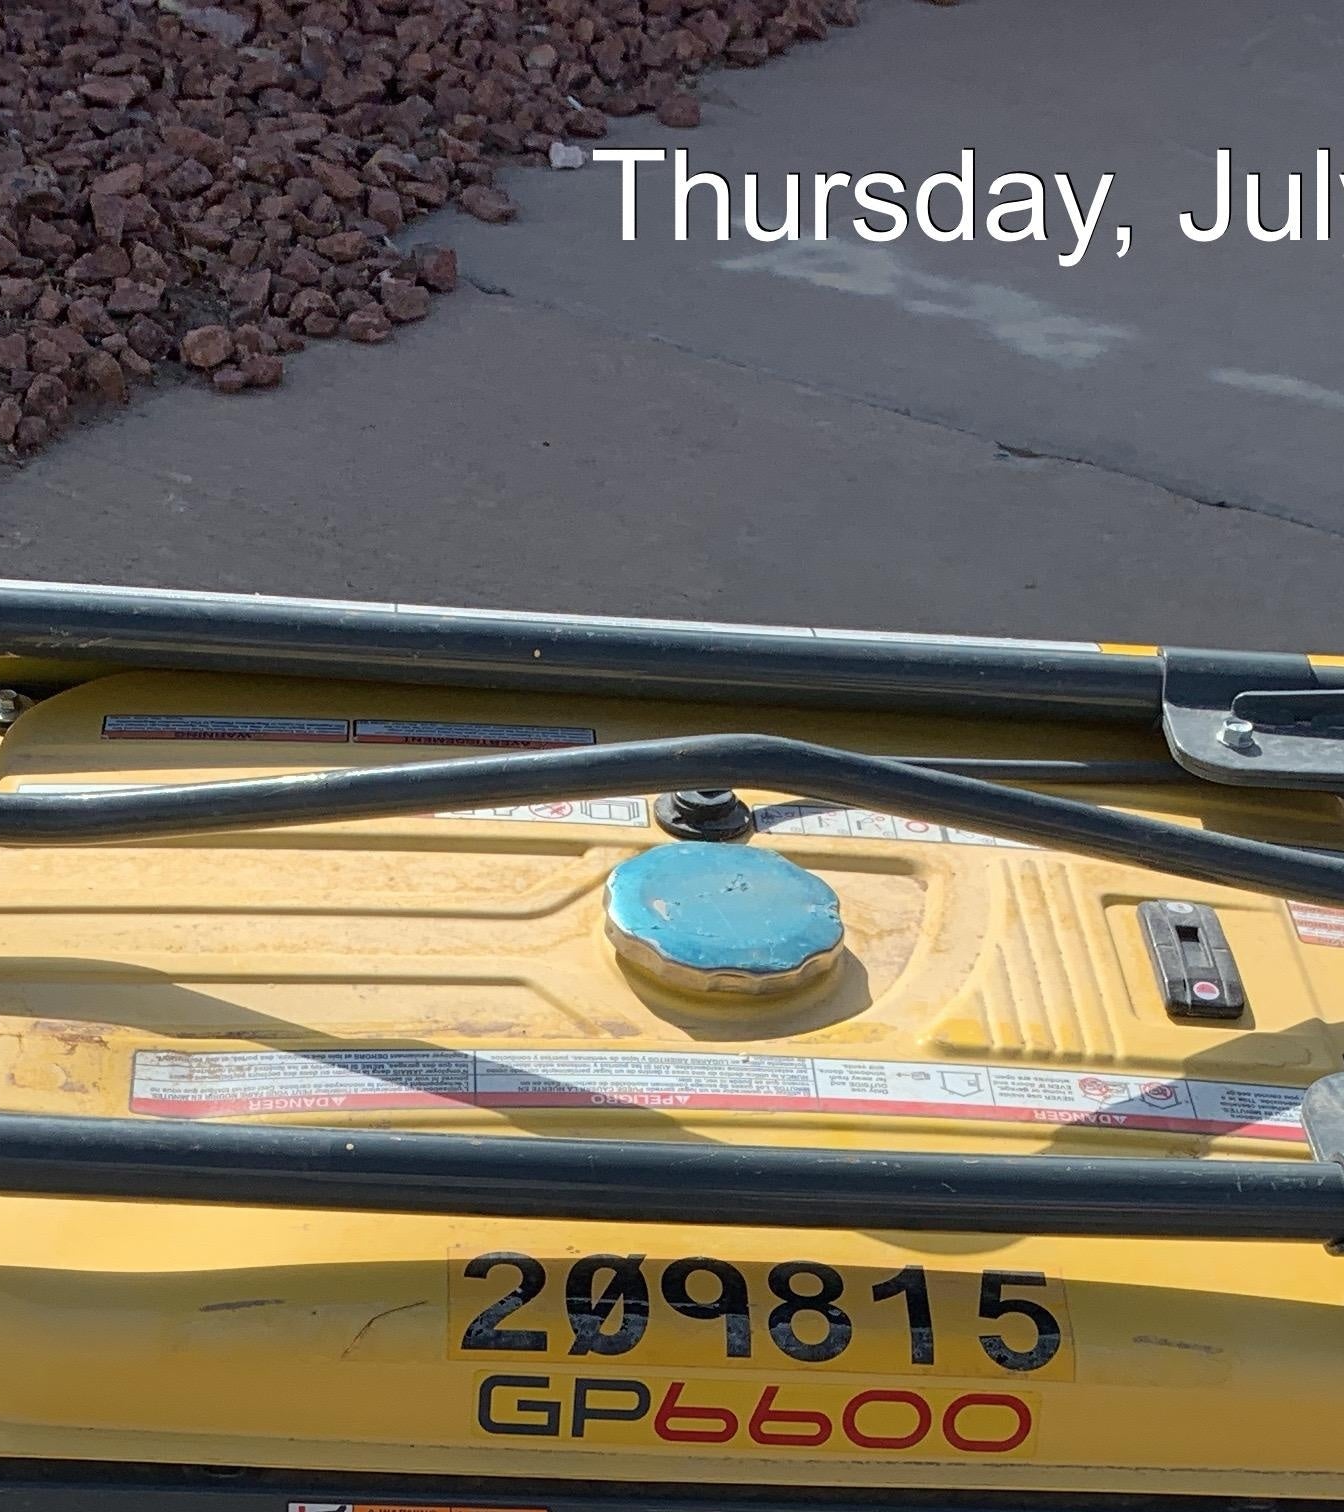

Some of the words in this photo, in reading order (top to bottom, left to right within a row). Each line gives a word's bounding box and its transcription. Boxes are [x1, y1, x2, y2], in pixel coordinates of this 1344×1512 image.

[247, 1097, 329, 1110] DANGER
[591, 1094, 674, 1105] PELIGRO
[1032, 1109, 1112, 1124] DANGER
[478, 1375, 1032, 1453] GP6600
